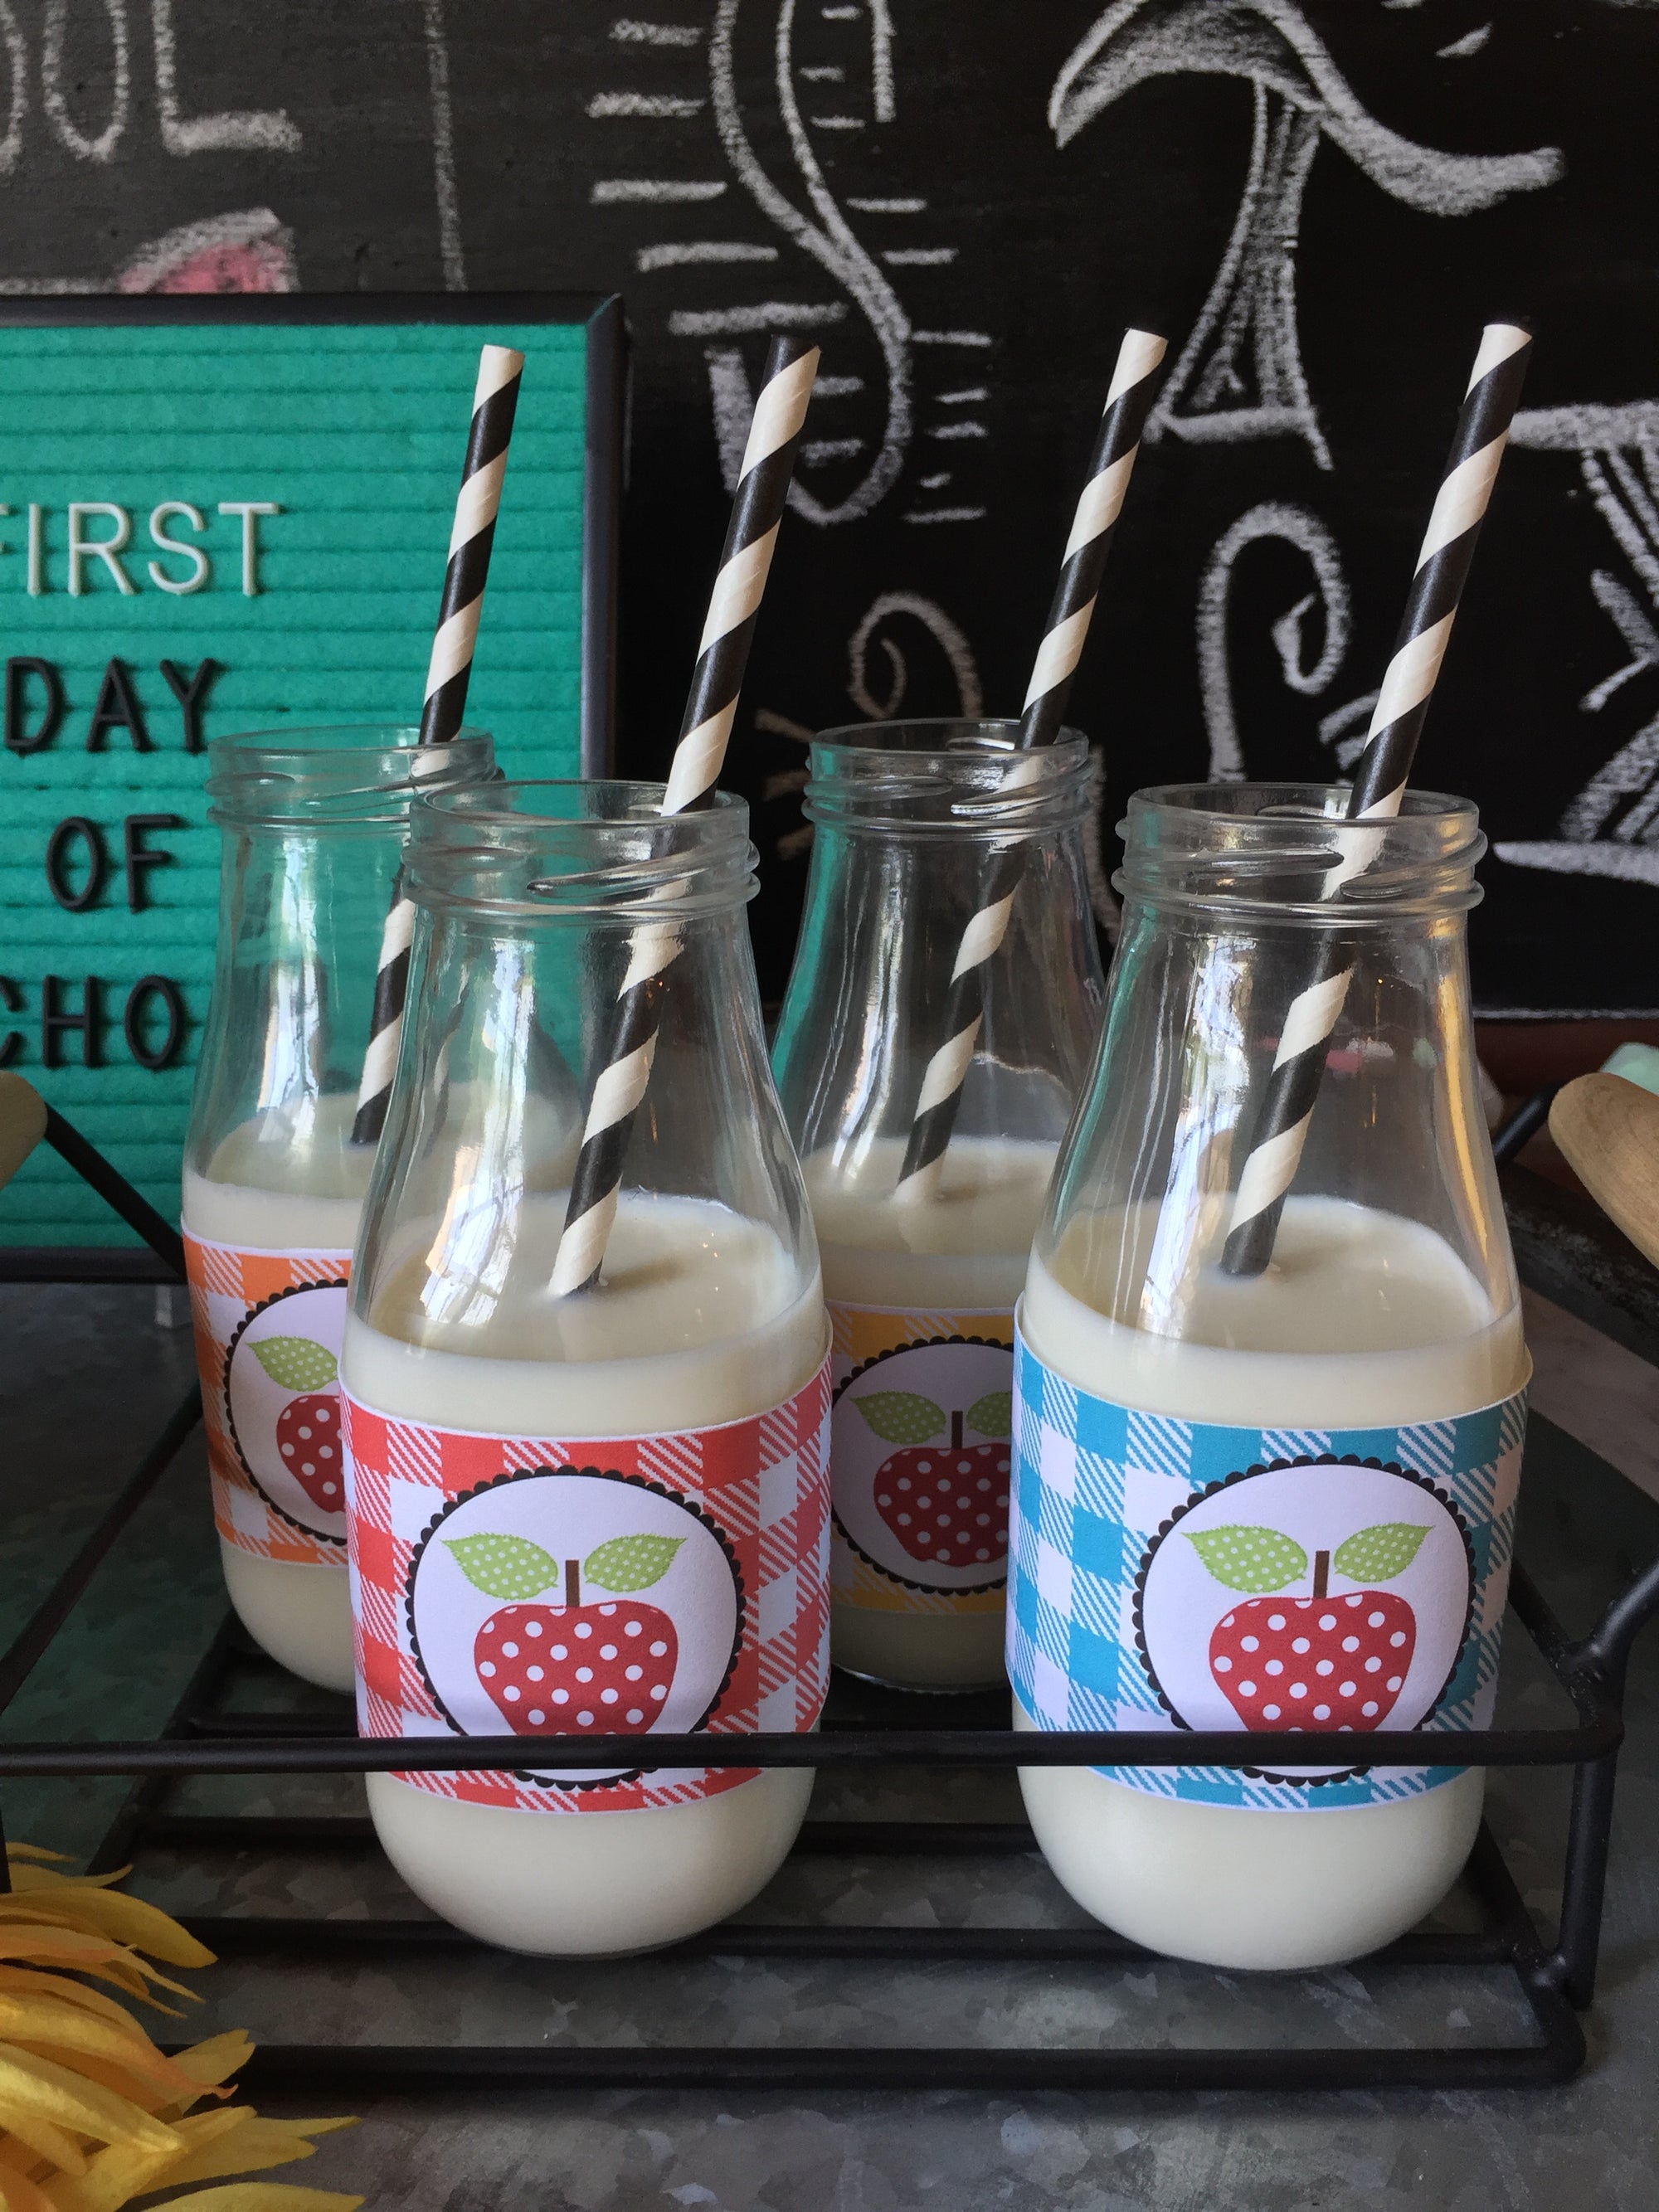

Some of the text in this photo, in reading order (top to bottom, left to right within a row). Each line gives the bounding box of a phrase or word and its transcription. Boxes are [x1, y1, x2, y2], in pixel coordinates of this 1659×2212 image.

[0, 501, 280, 596] IRST
[5, 655, 218, 756] DAY
[46, 814, 178, 913] OF
